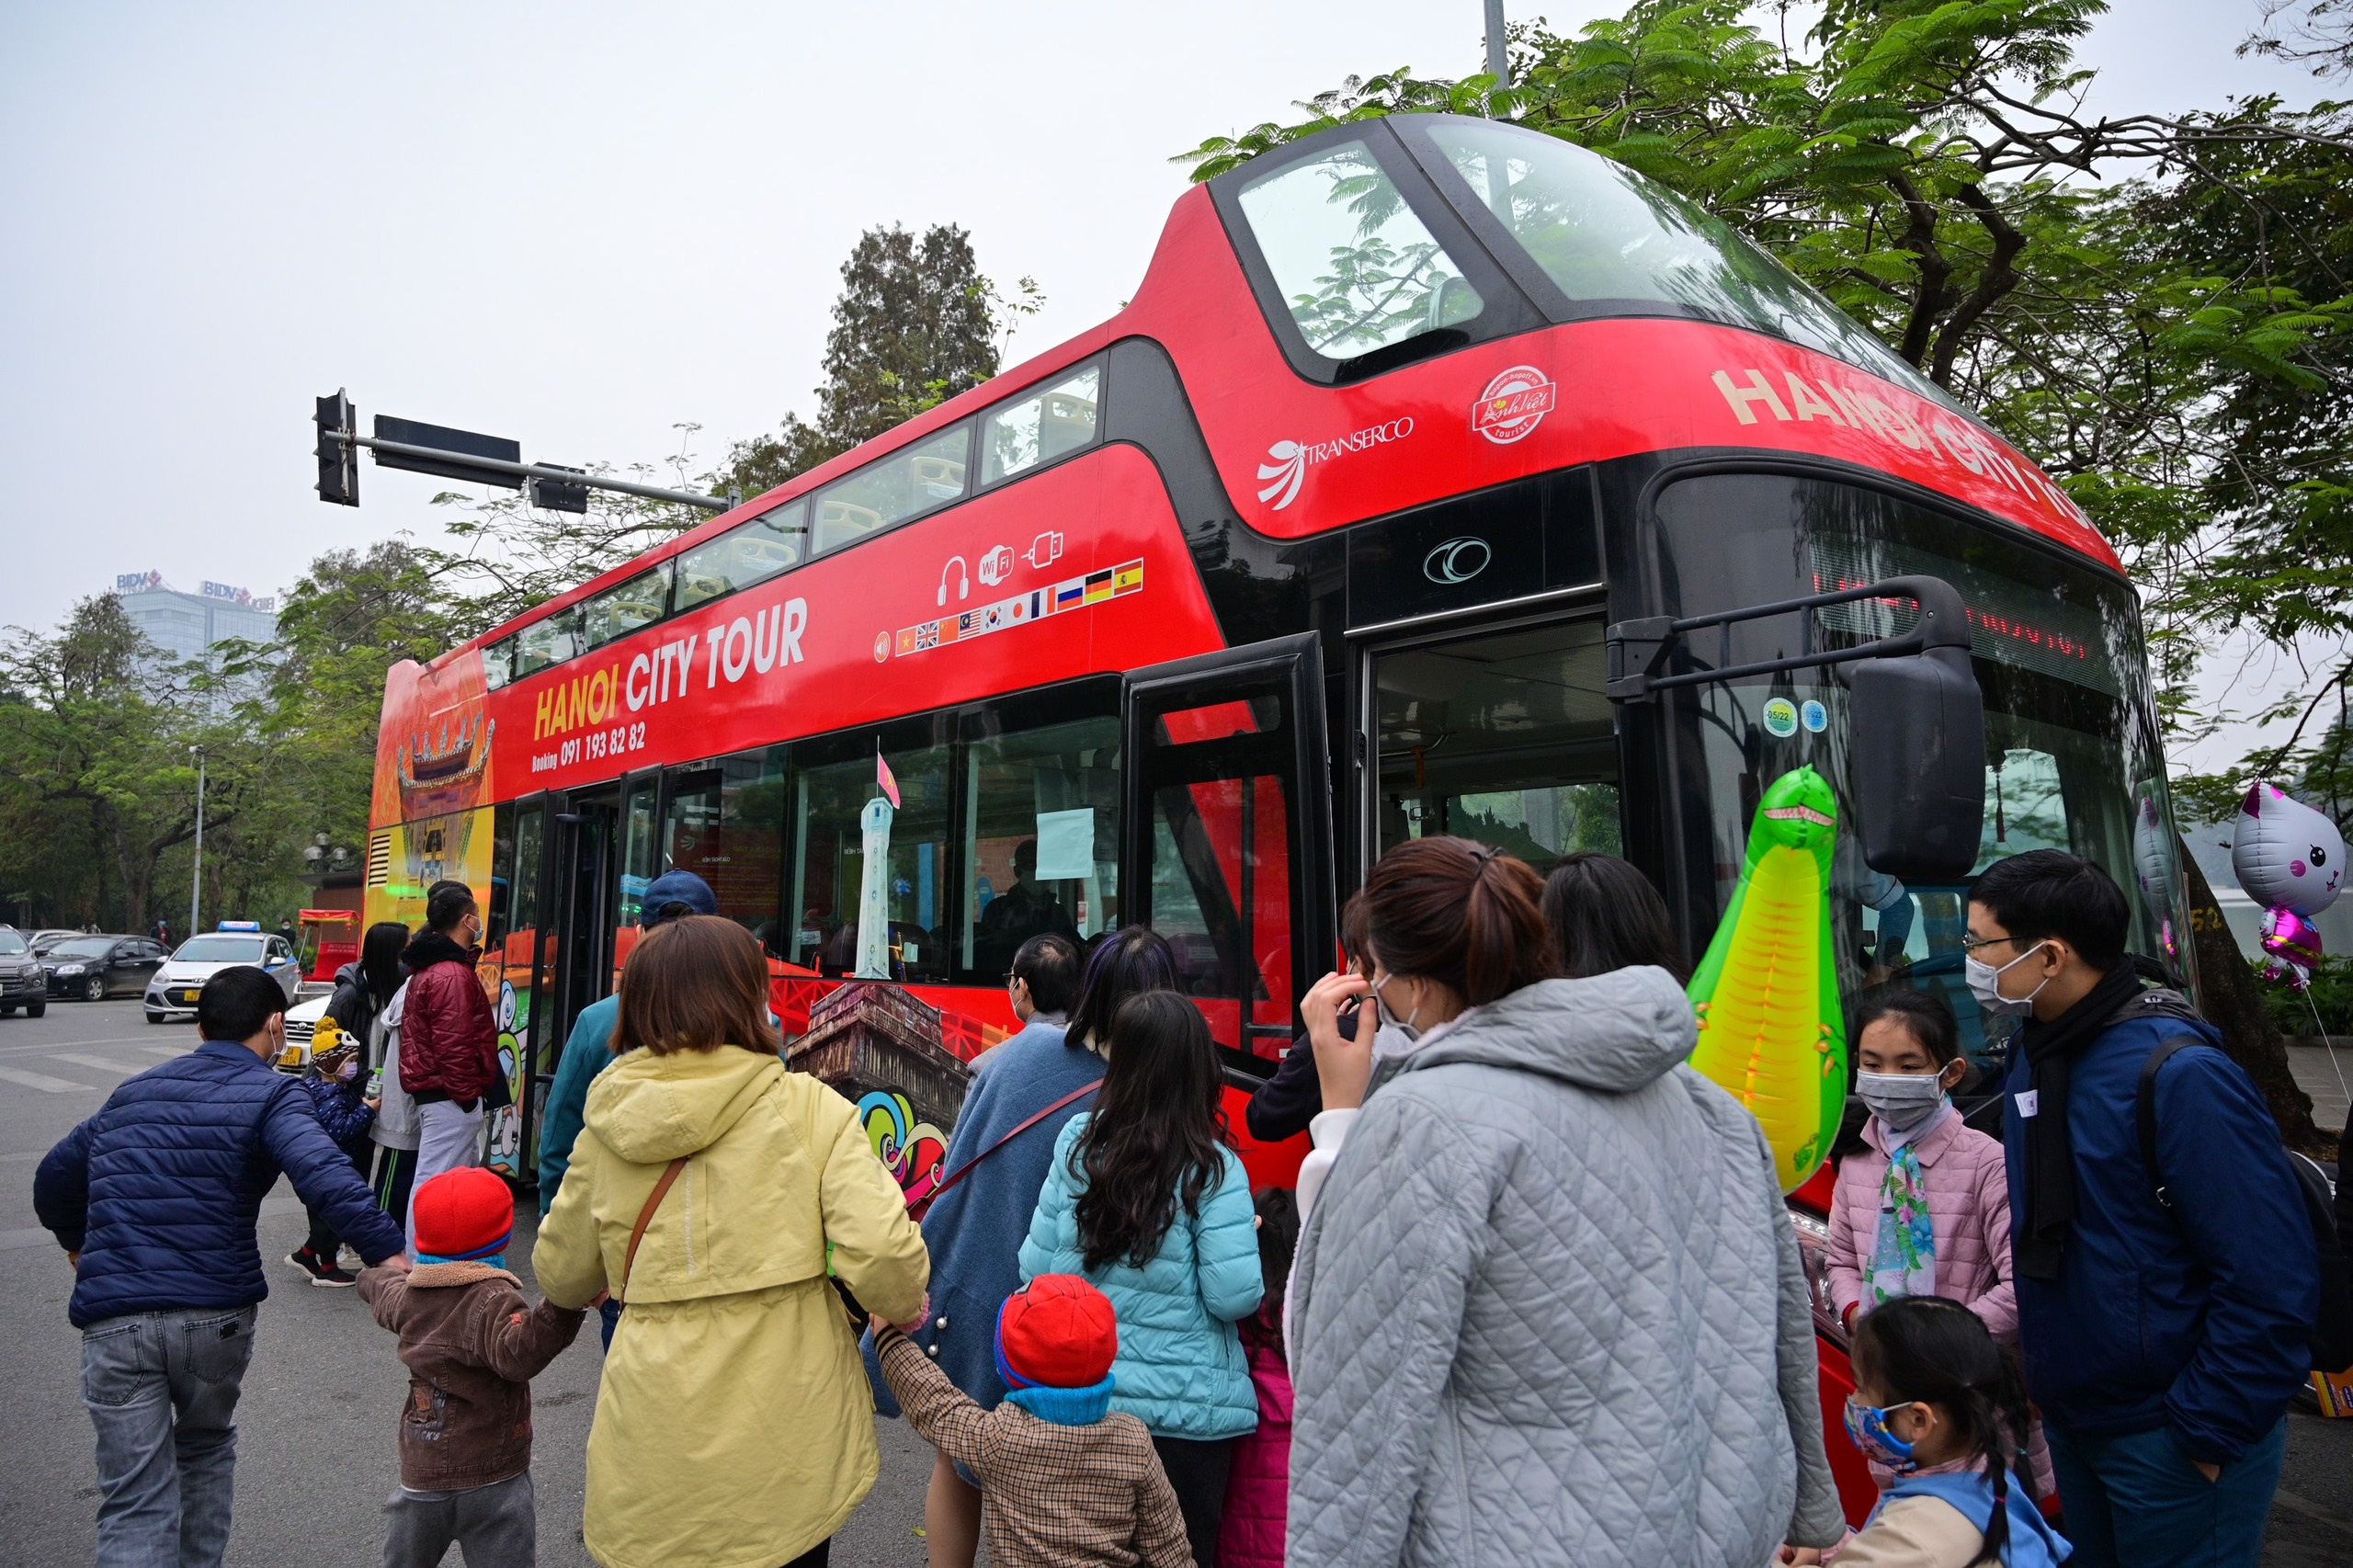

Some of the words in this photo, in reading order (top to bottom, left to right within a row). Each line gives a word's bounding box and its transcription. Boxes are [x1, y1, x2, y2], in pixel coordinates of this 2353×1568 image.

[1305, 416, 1414, 465] TRANSERCO
[1495, 422, 1529, 437] tourist
[1711, 369, 1943, 460] HANOI
[1933, 422, 2039, 503] CITY
[2021, 467, 2105, 539] TO
[117, 572, 148, 588] BIDV
[204, 581, 237, 598] BIDV
[534, 663, 620, 741] HANOI
[626, 634, 698, 712] CITY
[708, 597, 808, 688] TOUR
[532, 751, 558, 773] Booking
[561, 738, 581, 767] 091
[585, 733, 607, 761] 193
[609, 726, 626, 756] 82
[629, 722, 646, 751] 82
